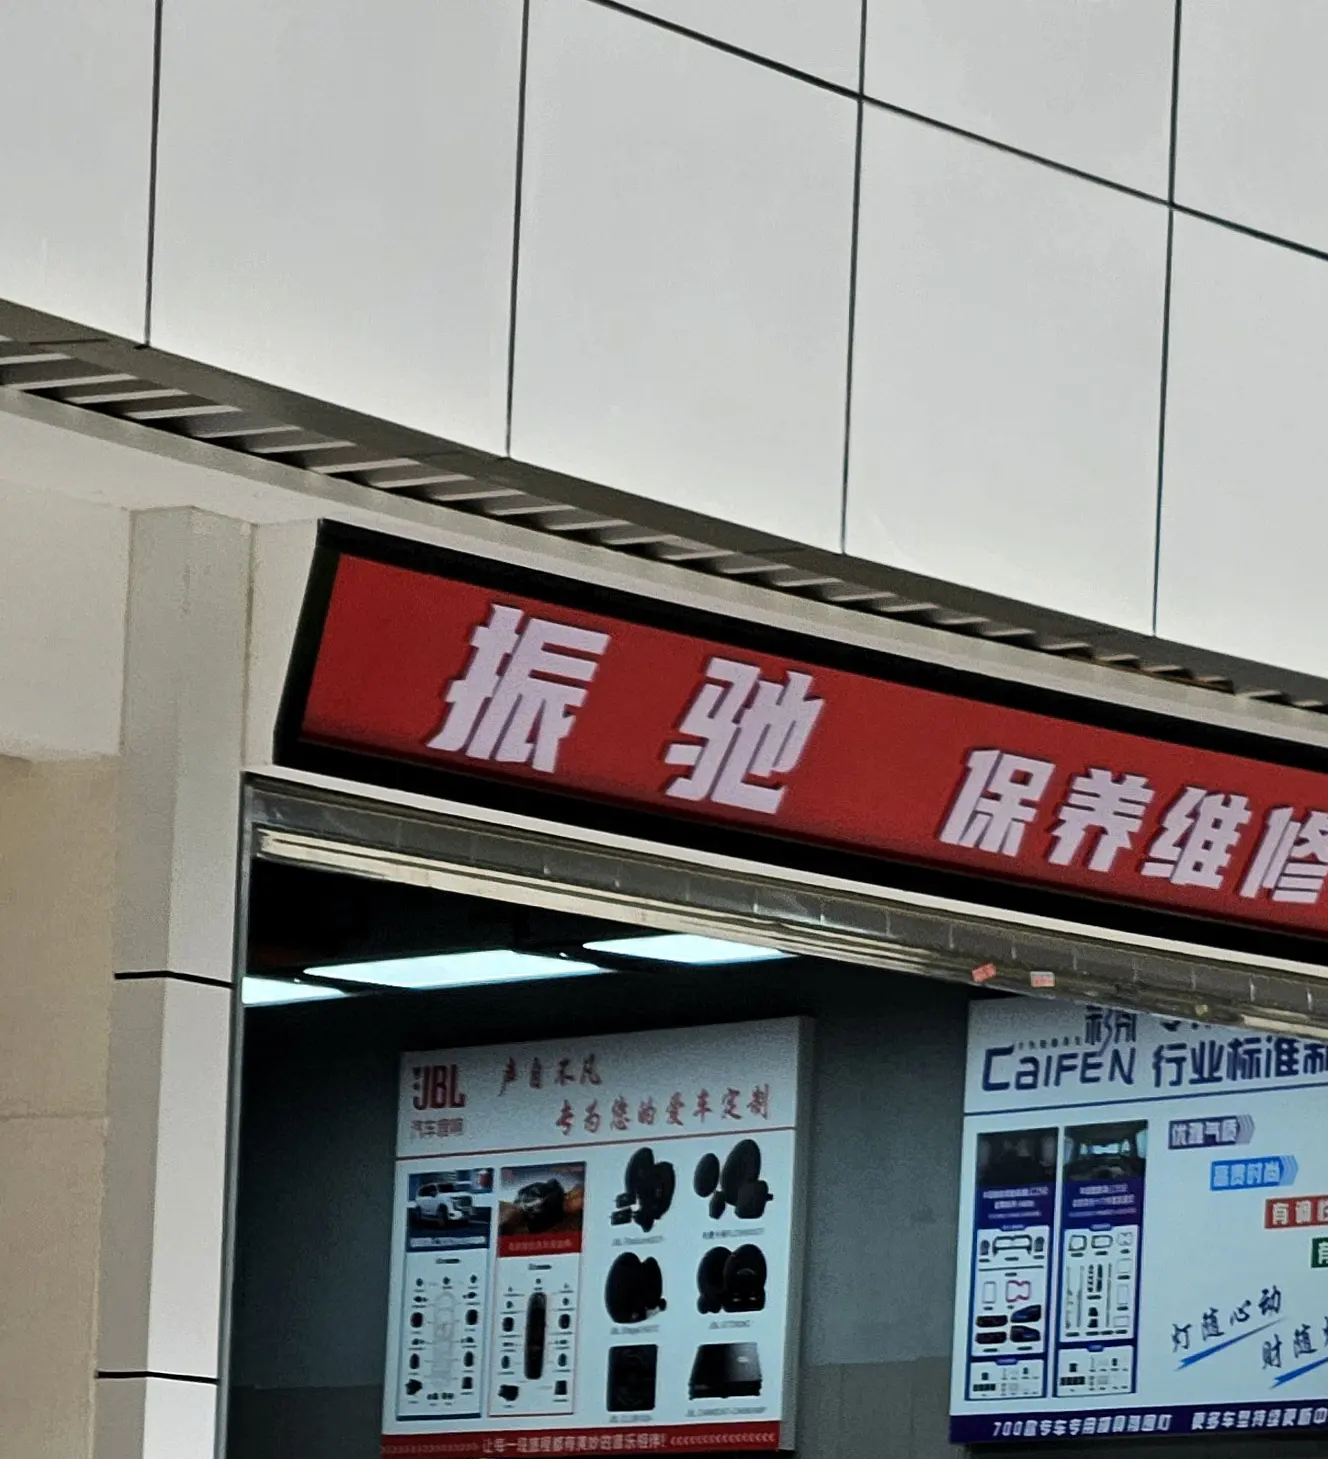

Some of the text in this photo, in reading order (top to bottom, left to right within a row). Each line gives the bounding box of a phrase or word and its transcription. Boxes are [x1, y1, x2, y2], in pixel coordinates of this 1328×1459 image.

[426, 602, 825, 815] 振驰
[412, 1064, 467, 1111] JBL
[555, 1083, 771, 1136] 专为您的爱车定制
[1171, 1284, 1282, 1353] 灯随心动
